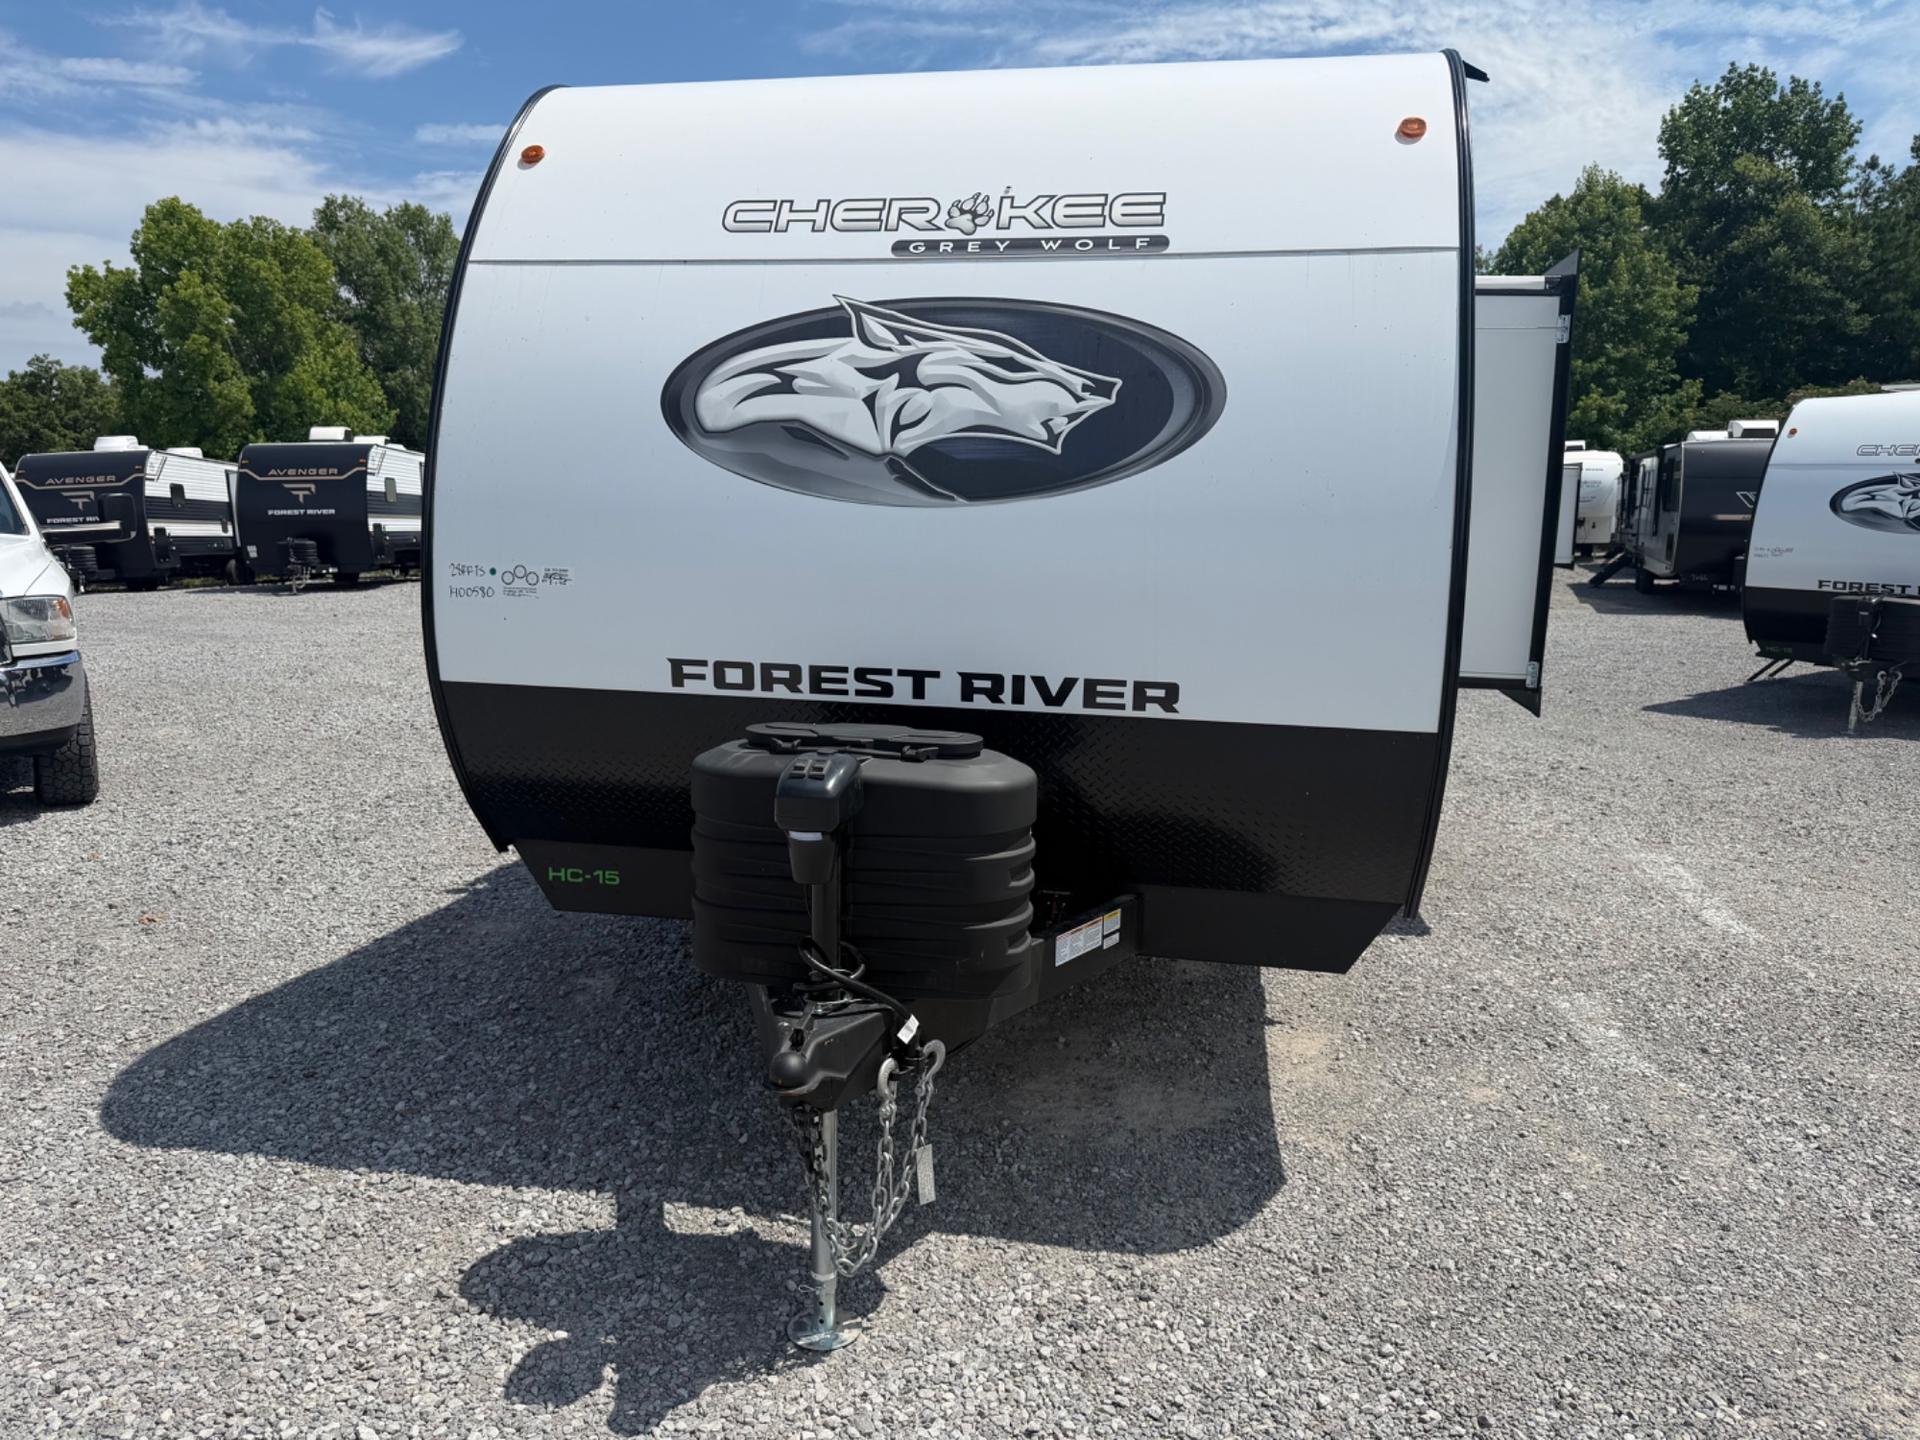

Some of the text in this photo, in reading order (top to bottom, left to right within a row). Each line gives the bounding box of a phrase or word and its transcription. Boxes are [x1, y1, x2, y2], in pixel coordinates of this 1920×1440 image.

[908, 237, 1152, 254] GREY WOLF
[267, 468, 338, 476] AVENGER
[45, 475, 116, 485] AVENGER
[267, 508, 336, 516] FOREST RIVER
[46, 516, 84, 524] FOREST
[1817, 579, 1912, 595] FOREST
[666, 657, 1180, 714] FOREST RIVER
[548, 866, 620, 885] HC-15
